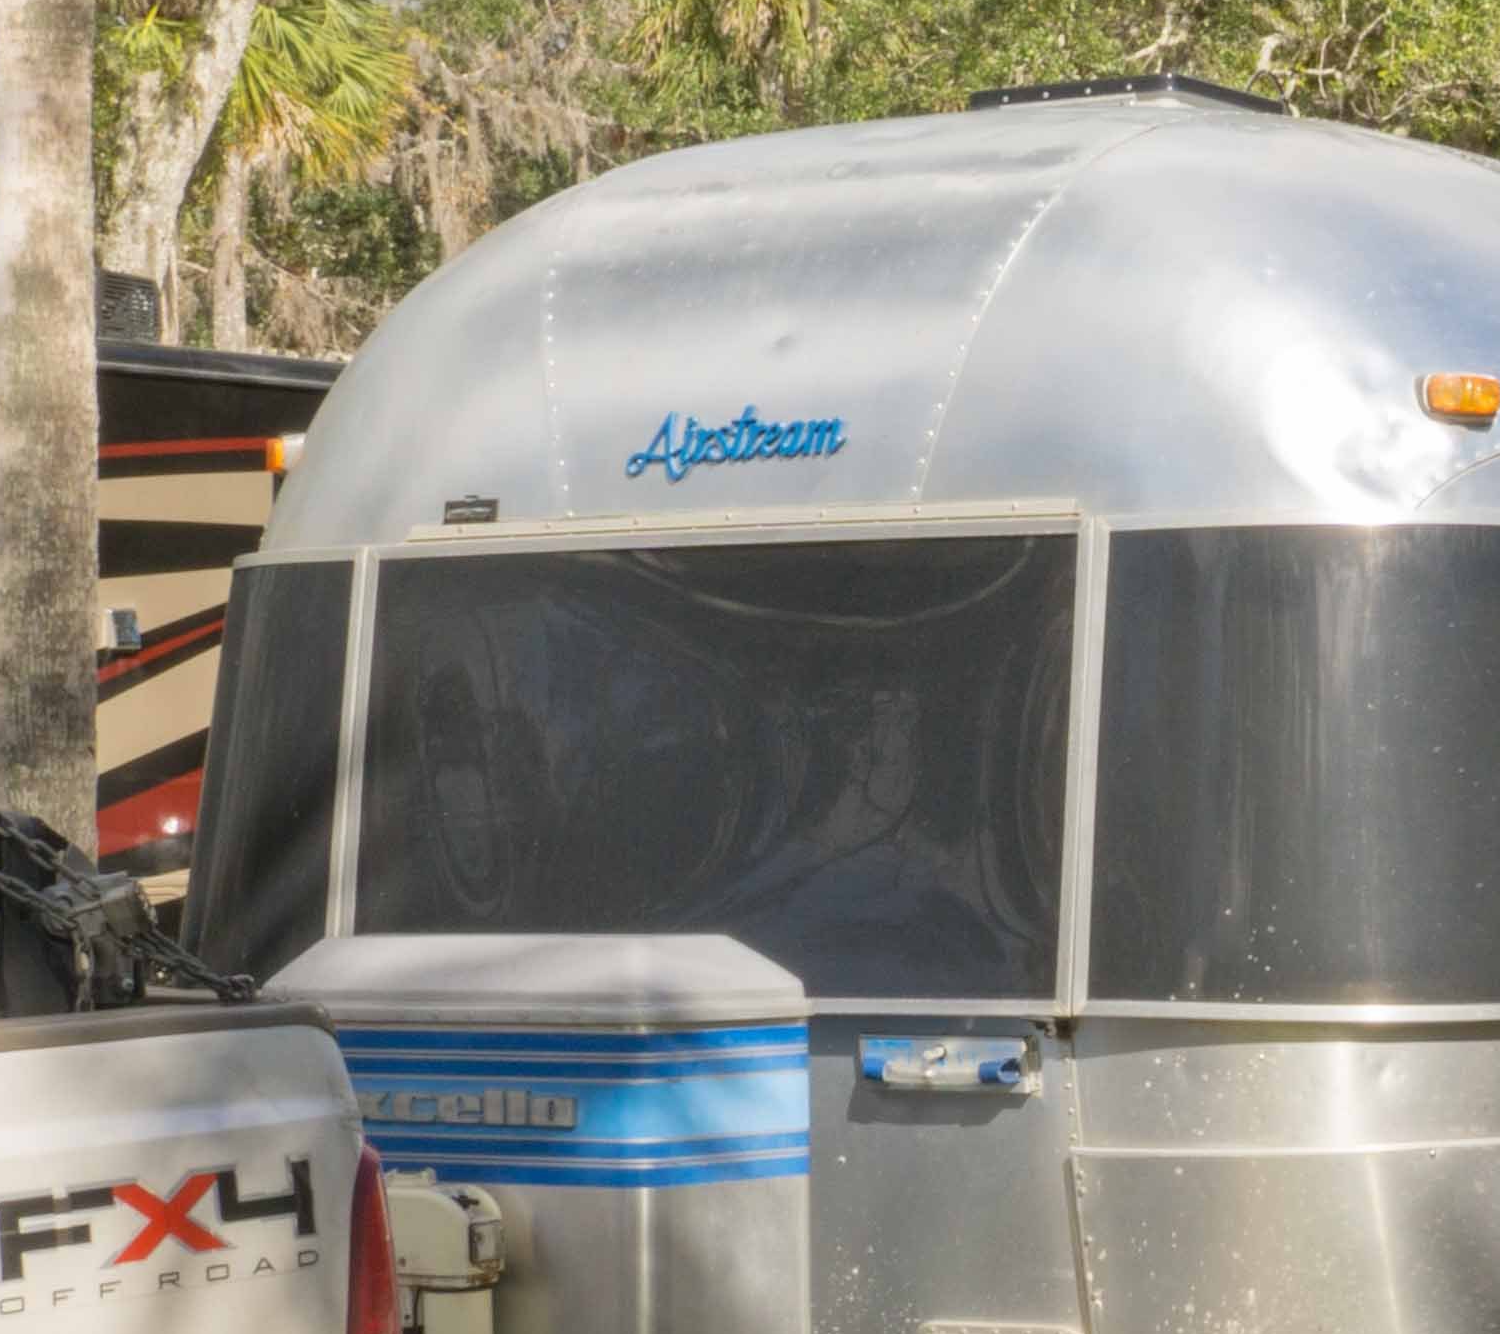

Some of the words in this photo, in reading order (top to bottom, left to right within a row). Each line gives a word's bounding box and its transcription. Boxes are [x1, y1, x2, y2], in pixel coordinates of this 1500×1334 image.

[626, 404, 846, 484] Airstream
[0, 1280, 122, 1315] OFF
[158, 1249, 319, 1289] ROAD
